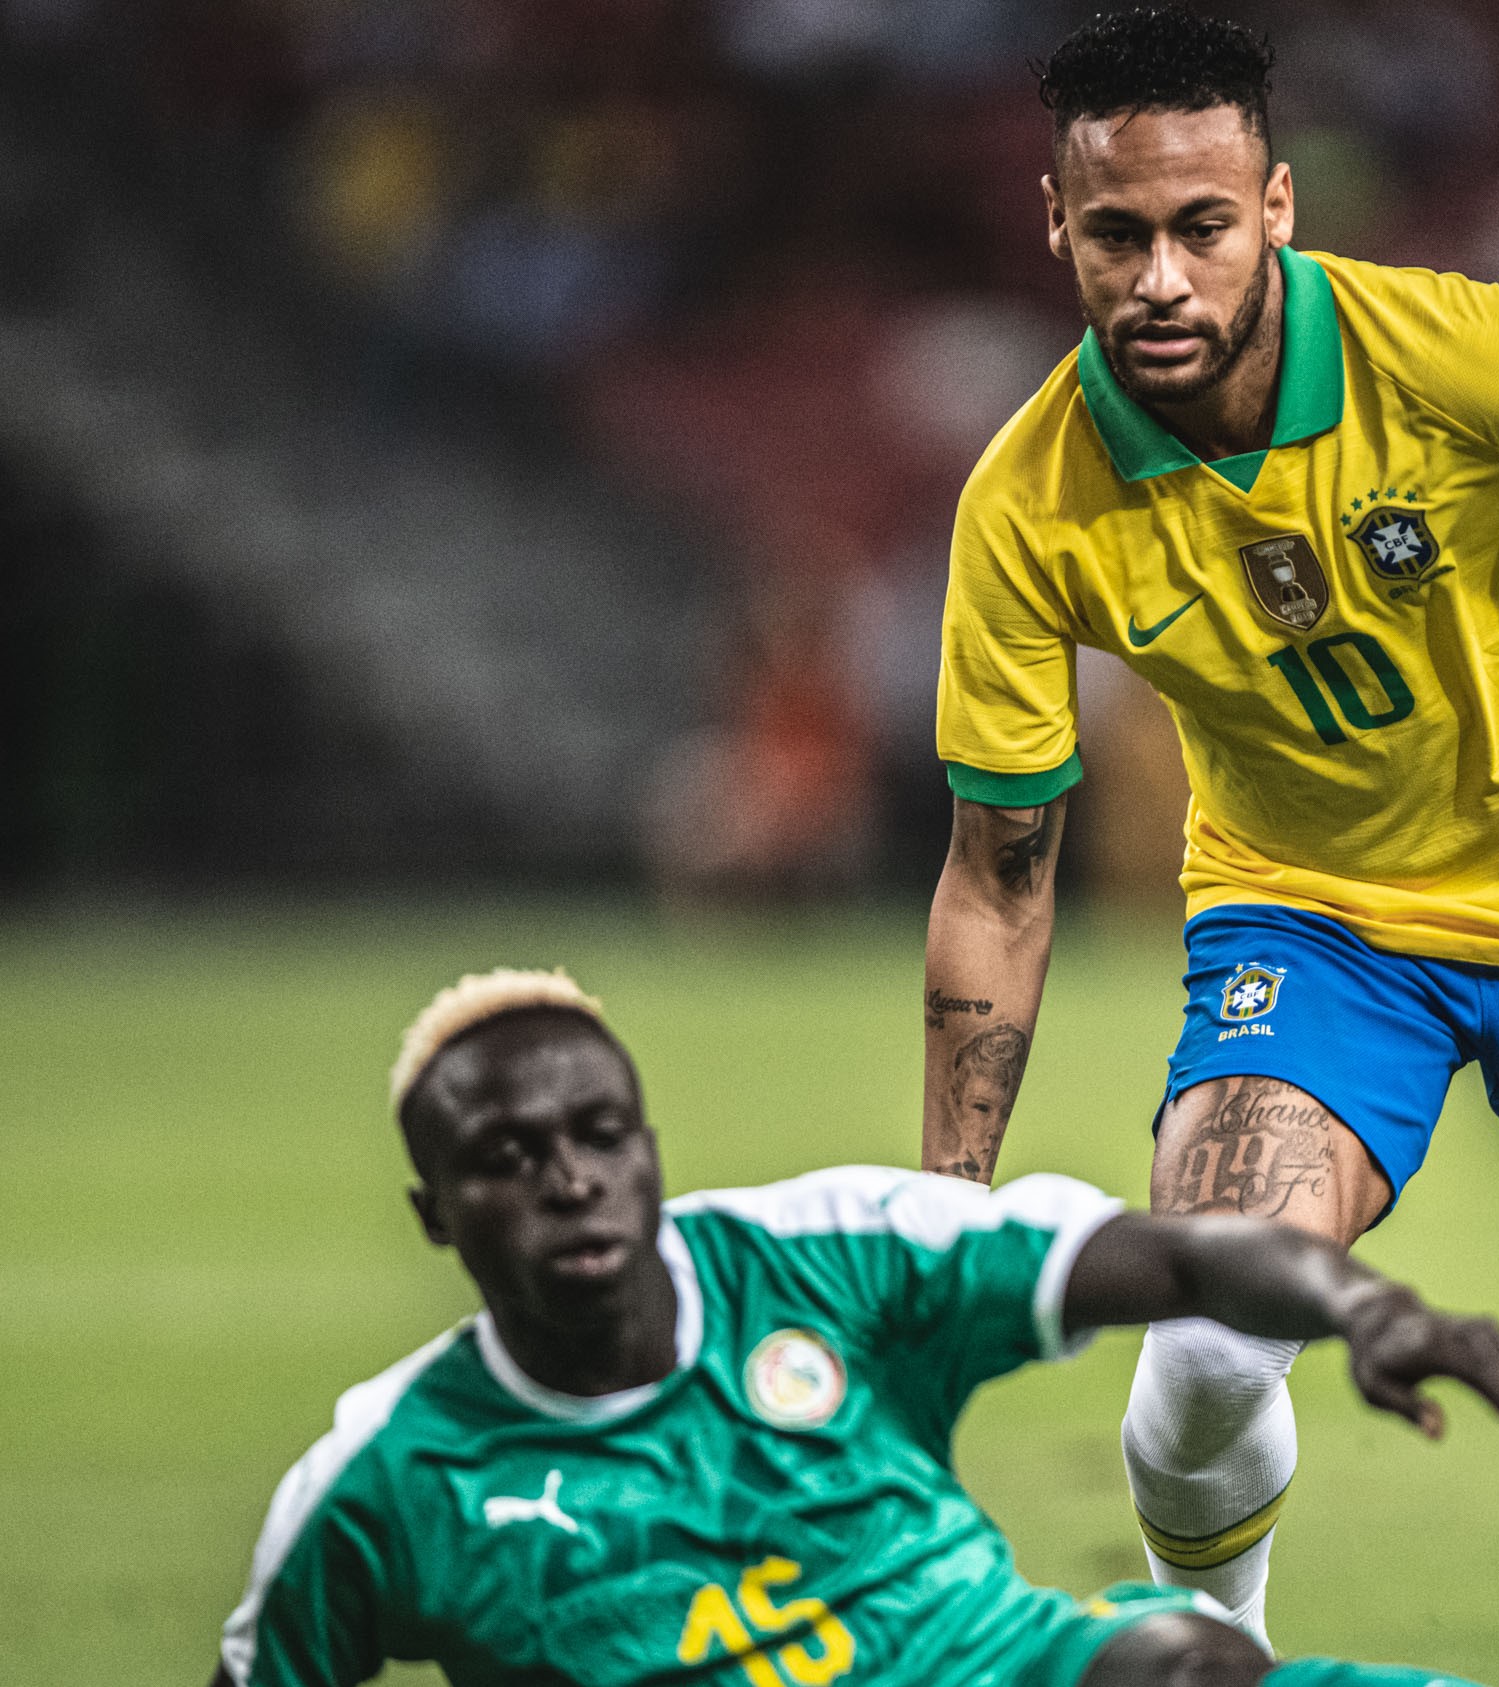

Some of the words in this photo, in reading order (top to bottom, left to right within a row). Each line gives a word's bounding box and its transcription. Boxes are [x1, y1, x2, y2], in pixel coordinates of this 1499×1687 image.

[1384, 534, 1409, 550] CBF
[1267, 632, 1415, 746] 10
[1218, 1023, 1275, 1042] BRASIL
[1211, 1091, 1330, 1133] Chance
[677, 1556, 856, 1687] 15
